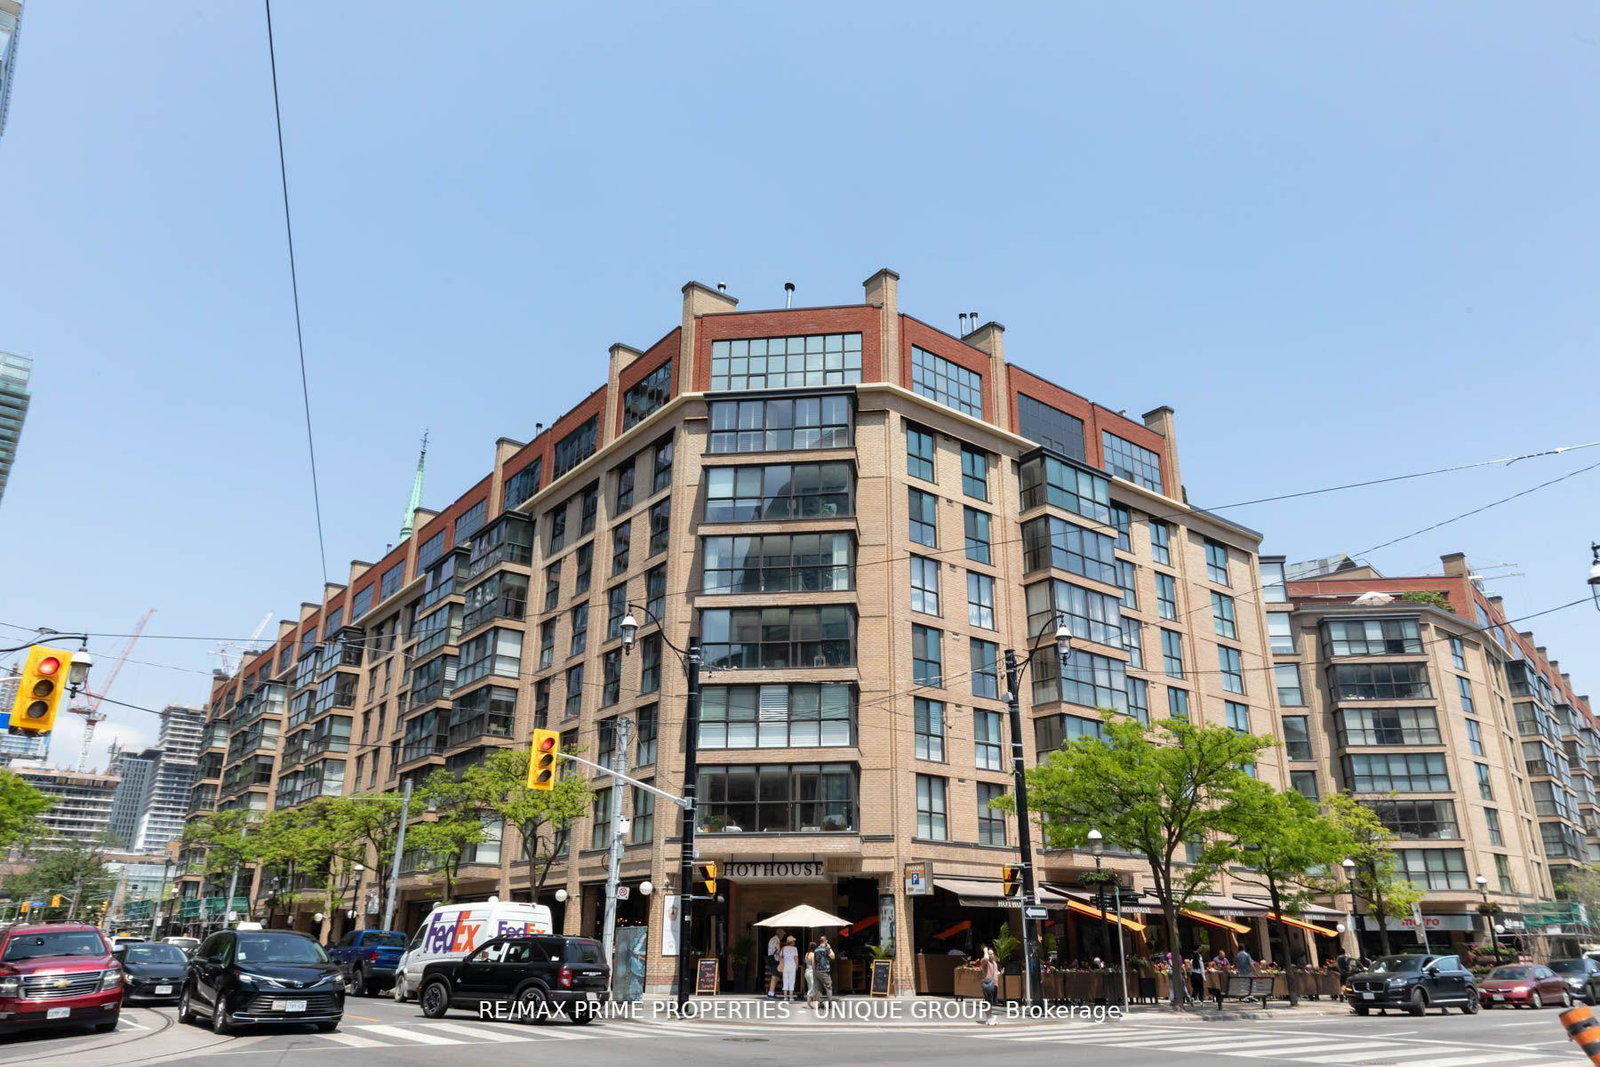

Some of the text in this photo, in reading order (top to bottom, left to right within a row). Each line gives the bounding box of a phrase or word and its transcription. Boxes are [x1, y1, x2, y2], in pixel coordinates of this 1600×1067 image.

[723, 862, 824, 877] HOTHOUSE
[424, 910, 481, 954] FedEx
[497, 921, 546, 938] FedEx
